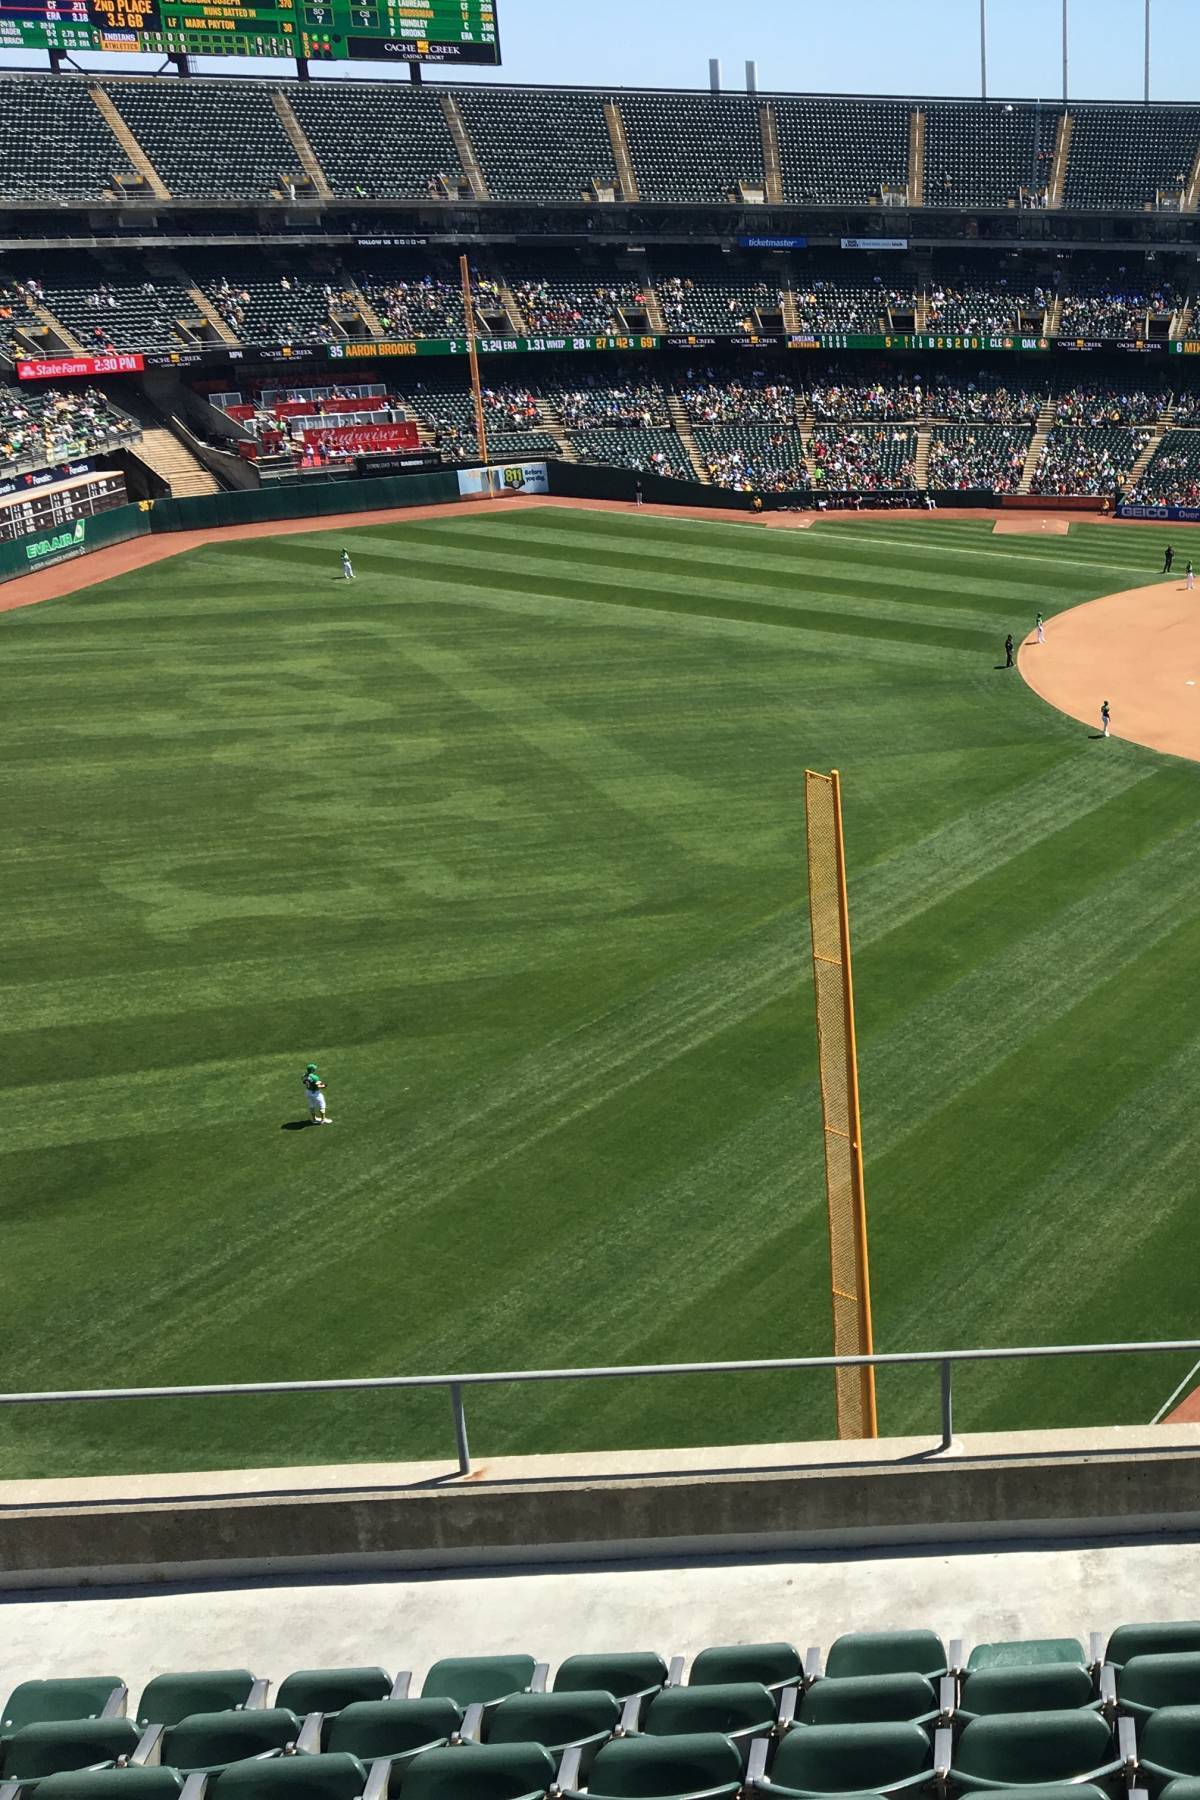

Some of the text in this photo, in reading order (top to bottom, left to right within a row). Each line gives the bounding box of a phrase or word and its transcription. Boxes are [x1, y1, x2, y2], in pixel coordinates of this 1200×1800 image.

[47, 1, 57, 9] CF
[94, 0, 153, 14] 2ND PLACE
[46, 12, 62, 21] ERA
[203, 6, 257, 18] RUNS BATTED IN
[107, 13, 144, 28] 3.5 GB
[167, 17, 177, 27] LF
[185, 18, 207, 29] MARK
[207, 19, 235, 30] PAYTON
[316, 16, 323, 24] 7
[103, 32, 136, 41] INDIANS
[390, 28, 396, 37] P
[400, 28, 426, 38] BROOKS
[461, 32, 473, 41] ERA
[384, 43, 461, 54] CACHE CREEK
[749, 238, 795, 247] ticketmaster
[330, 345, 343, 358] 35
[345, 344, 377, 357] AARON
[378, 343, 416, 356] BROOKS
[481, 339, 503, 351] 5.24
[503, 341, 517, 350] ERA
[526, 338, 546, 351] 1.31
[546, 340, 566, 349] WHIP
[573, 338, 585, 350] 28
[585, 339, 591, 348] K
[596, 338, 606, 349] 27
[616, 337, 628, 348] 42
[640, 336, 652, 348] 69
[929, 338, 934, 348] B
[937, 338, 943, 348] 2
[990, 338, 1002, 348] CLE
[1022, 339, 1036, 349] OAK
[1176, 342, 1183, 352] 6
[94, 359, 117, 372] 2:30
[119, 357, 136, 370] PM
[319, 428, 398, 443] Budweiser
[33, 464, 89, 485] Fanatics Fanatics
[505, 468, 523, 482] 811
[1121, 507, 1168, 518] GEICO
[1179, 510, 1199, 518] Over
